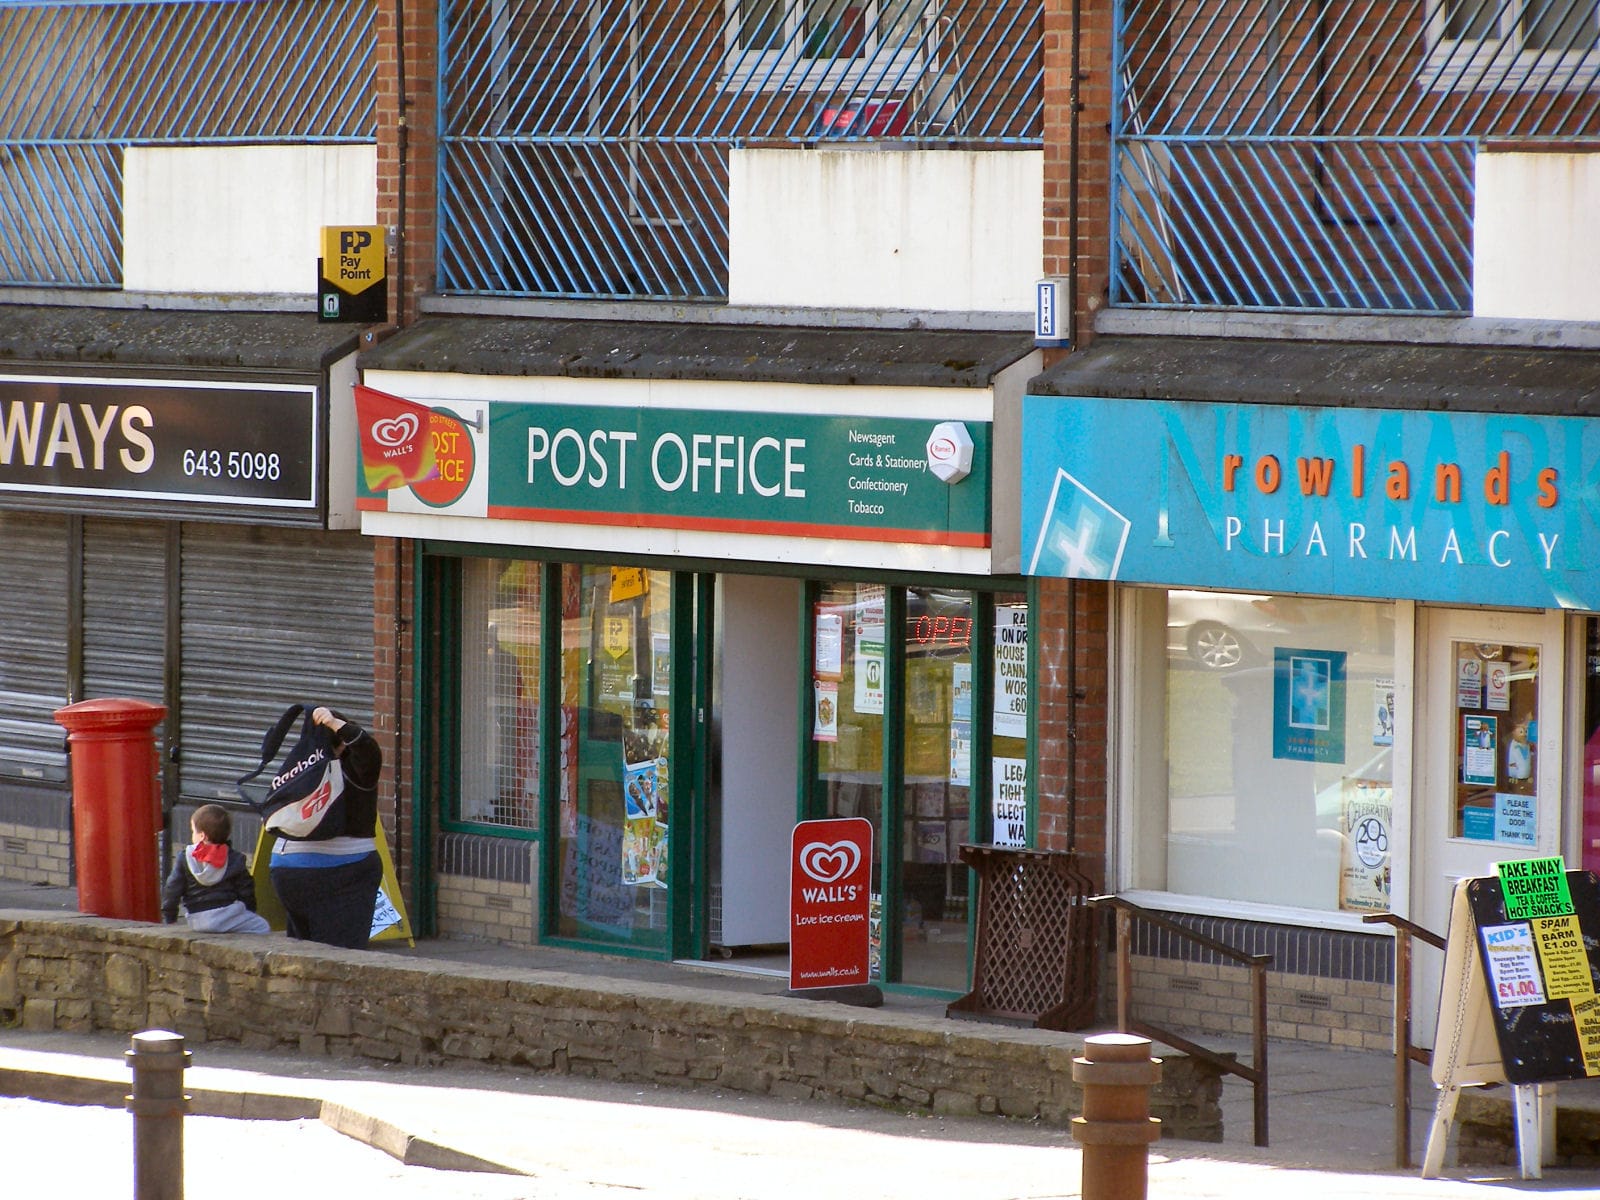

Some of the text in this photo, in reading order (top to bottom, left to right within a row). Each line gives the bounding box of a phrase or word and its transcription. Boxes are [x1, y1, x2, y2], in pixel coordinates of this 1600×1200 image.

[340, 256, 361, 270] Pay
[340, 268, 371, 279] Point
[848, 430, 896, 447] Newsagent
[384, 444, 414, 458] WALL'S
[183, 449, 280, 480] 643 5098
[528, 426, 806, 498] POST OFFICE
[848, 453, 928, 473] Cards & Stationery
[1223, 444, 1559, 508] rowlands
[848, 476, 908, 495] Confectionery
[848, 500, 884, 514] Tobacco
[1225, 516, 1559, 569] PHARMACY
[1002, 628, 1014, 644] ON
[996, 644, 1025, 661] HOUSE
[1000, 662, 1027, 679] CANN
[272, 748, 325, 791] Reebok
[1507, 799, 1530, 809] PLEASE
[1502, 808, 1521, 818] CLOSE
[1522, 810, 1534, 819] THE
[1509, 818, 1526, 827] DOOR
[1501, 830, 1534, 841] THANK YOU
[1498, 859, 1561, 878] TAKE AWAY
[1508, 876, 1560, 896] BREAKFAST
[802, 885, 857, 904] WALL'S
[1516, 893, 1560, 906] TEA & COFFEE
[796, 913, 865, 925] Love ice cream
[1509, 906, 1530, 918] HOT
[1540, 918, 1570, 930] SPAM
[1542, 930, 1575, 942] BARM
[1544, 940, 1578, 950] £1.00
[800, 965, 860, 979] www.walls.co.uk
[1499, 980, 1536, 998] £1.00
